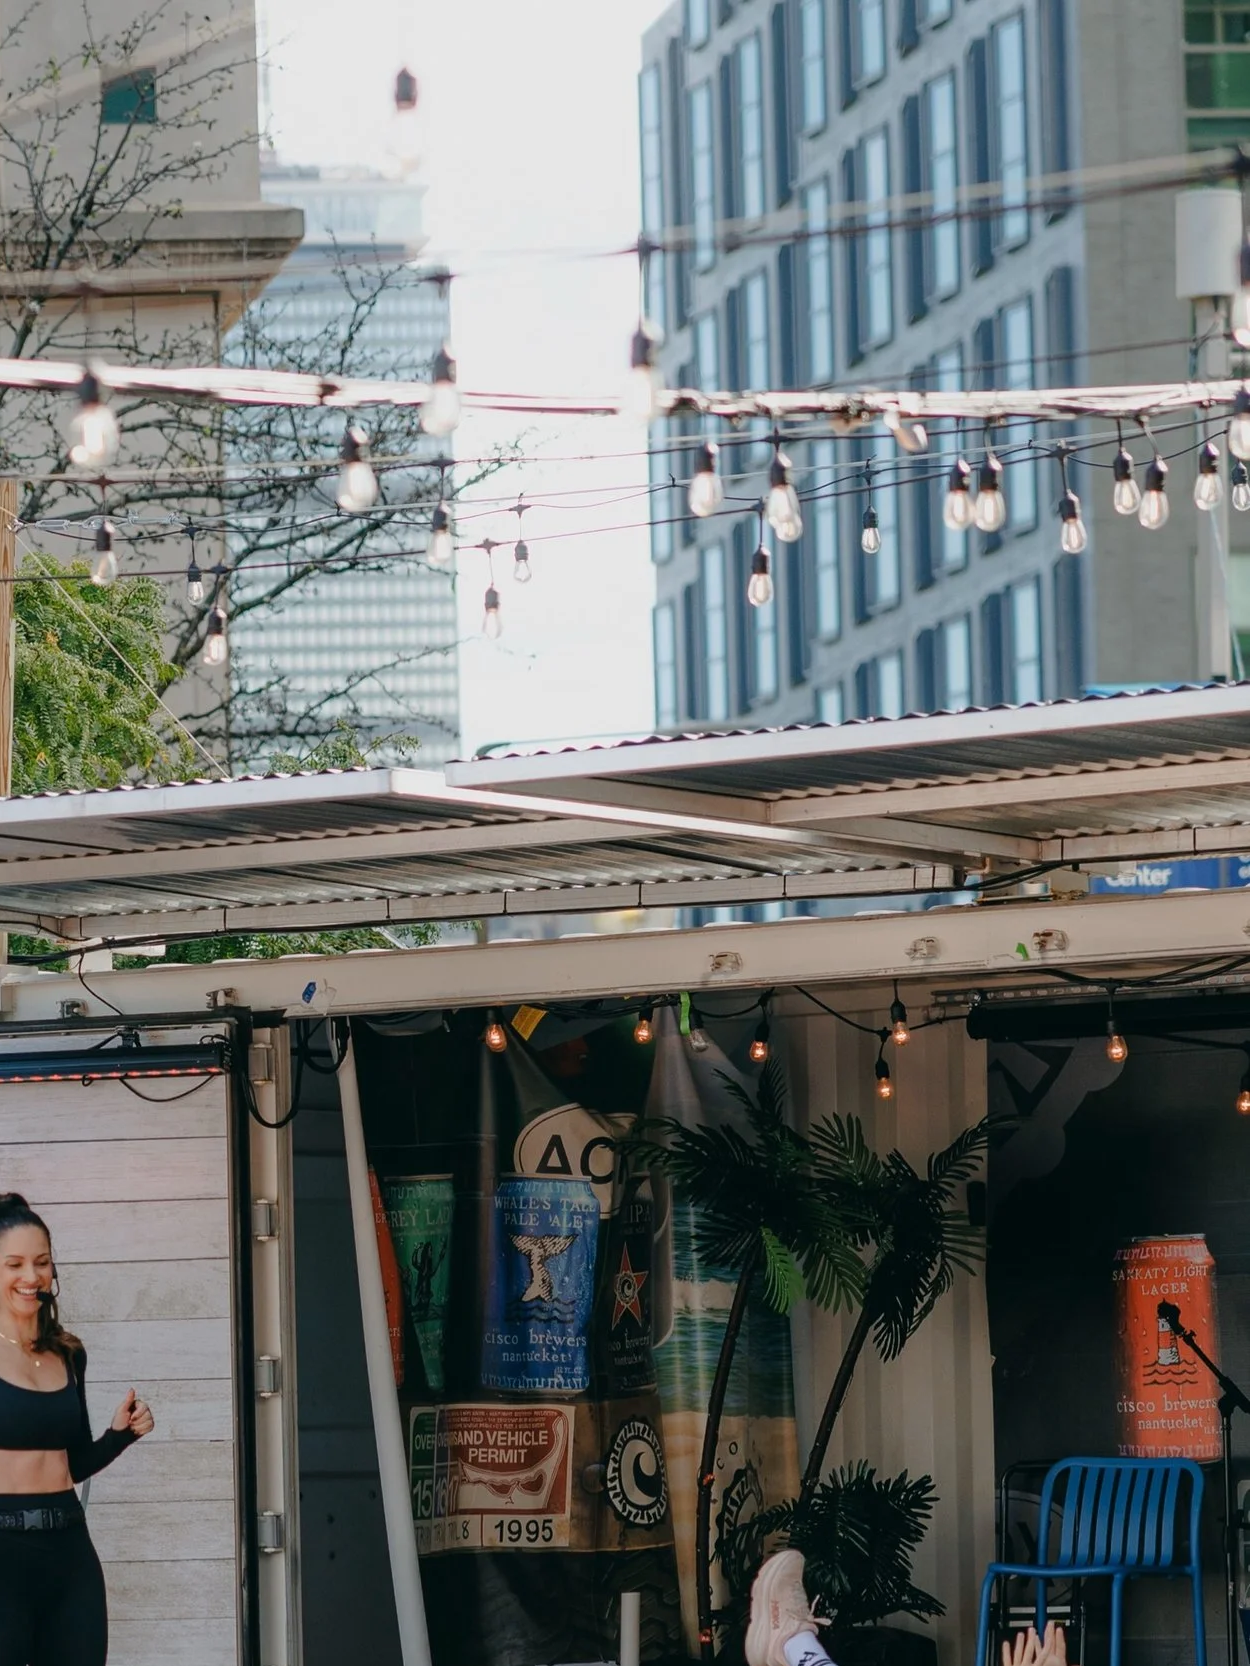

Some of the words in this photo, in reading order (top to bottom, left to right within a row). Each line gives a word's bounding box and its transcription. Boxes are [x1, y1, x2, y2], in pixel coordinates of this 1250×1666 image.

[536, 1135, 628, 1185] AC
[494, 1196, 551, 1211] WHALE'S
[388, 1210, 419, 1228] REY
[505, 1213, 540, 1226] PALE
[551, 1215, 583, 1228] ALE
[1174, 1265, 1209, 1278] LIGHT
[1142, 1282, 1189, 1295] LAGER
[485, 1330, 519, 1345] cisco
[529, 1328, 587, 1347] brewers
[502, 1349, 568, 1363] nantucket
[1116, 1395, 1155, 1412] cisco
[1163, 1393, 1218, 1412] brewers
[1138, 1413, 1203, 1429] nantucket
[486, 1430, 549, 1446] VEHICLE
[468, 1448, 528, 1464] PERMIT
[494, 1519, 554, 1543] 1995
